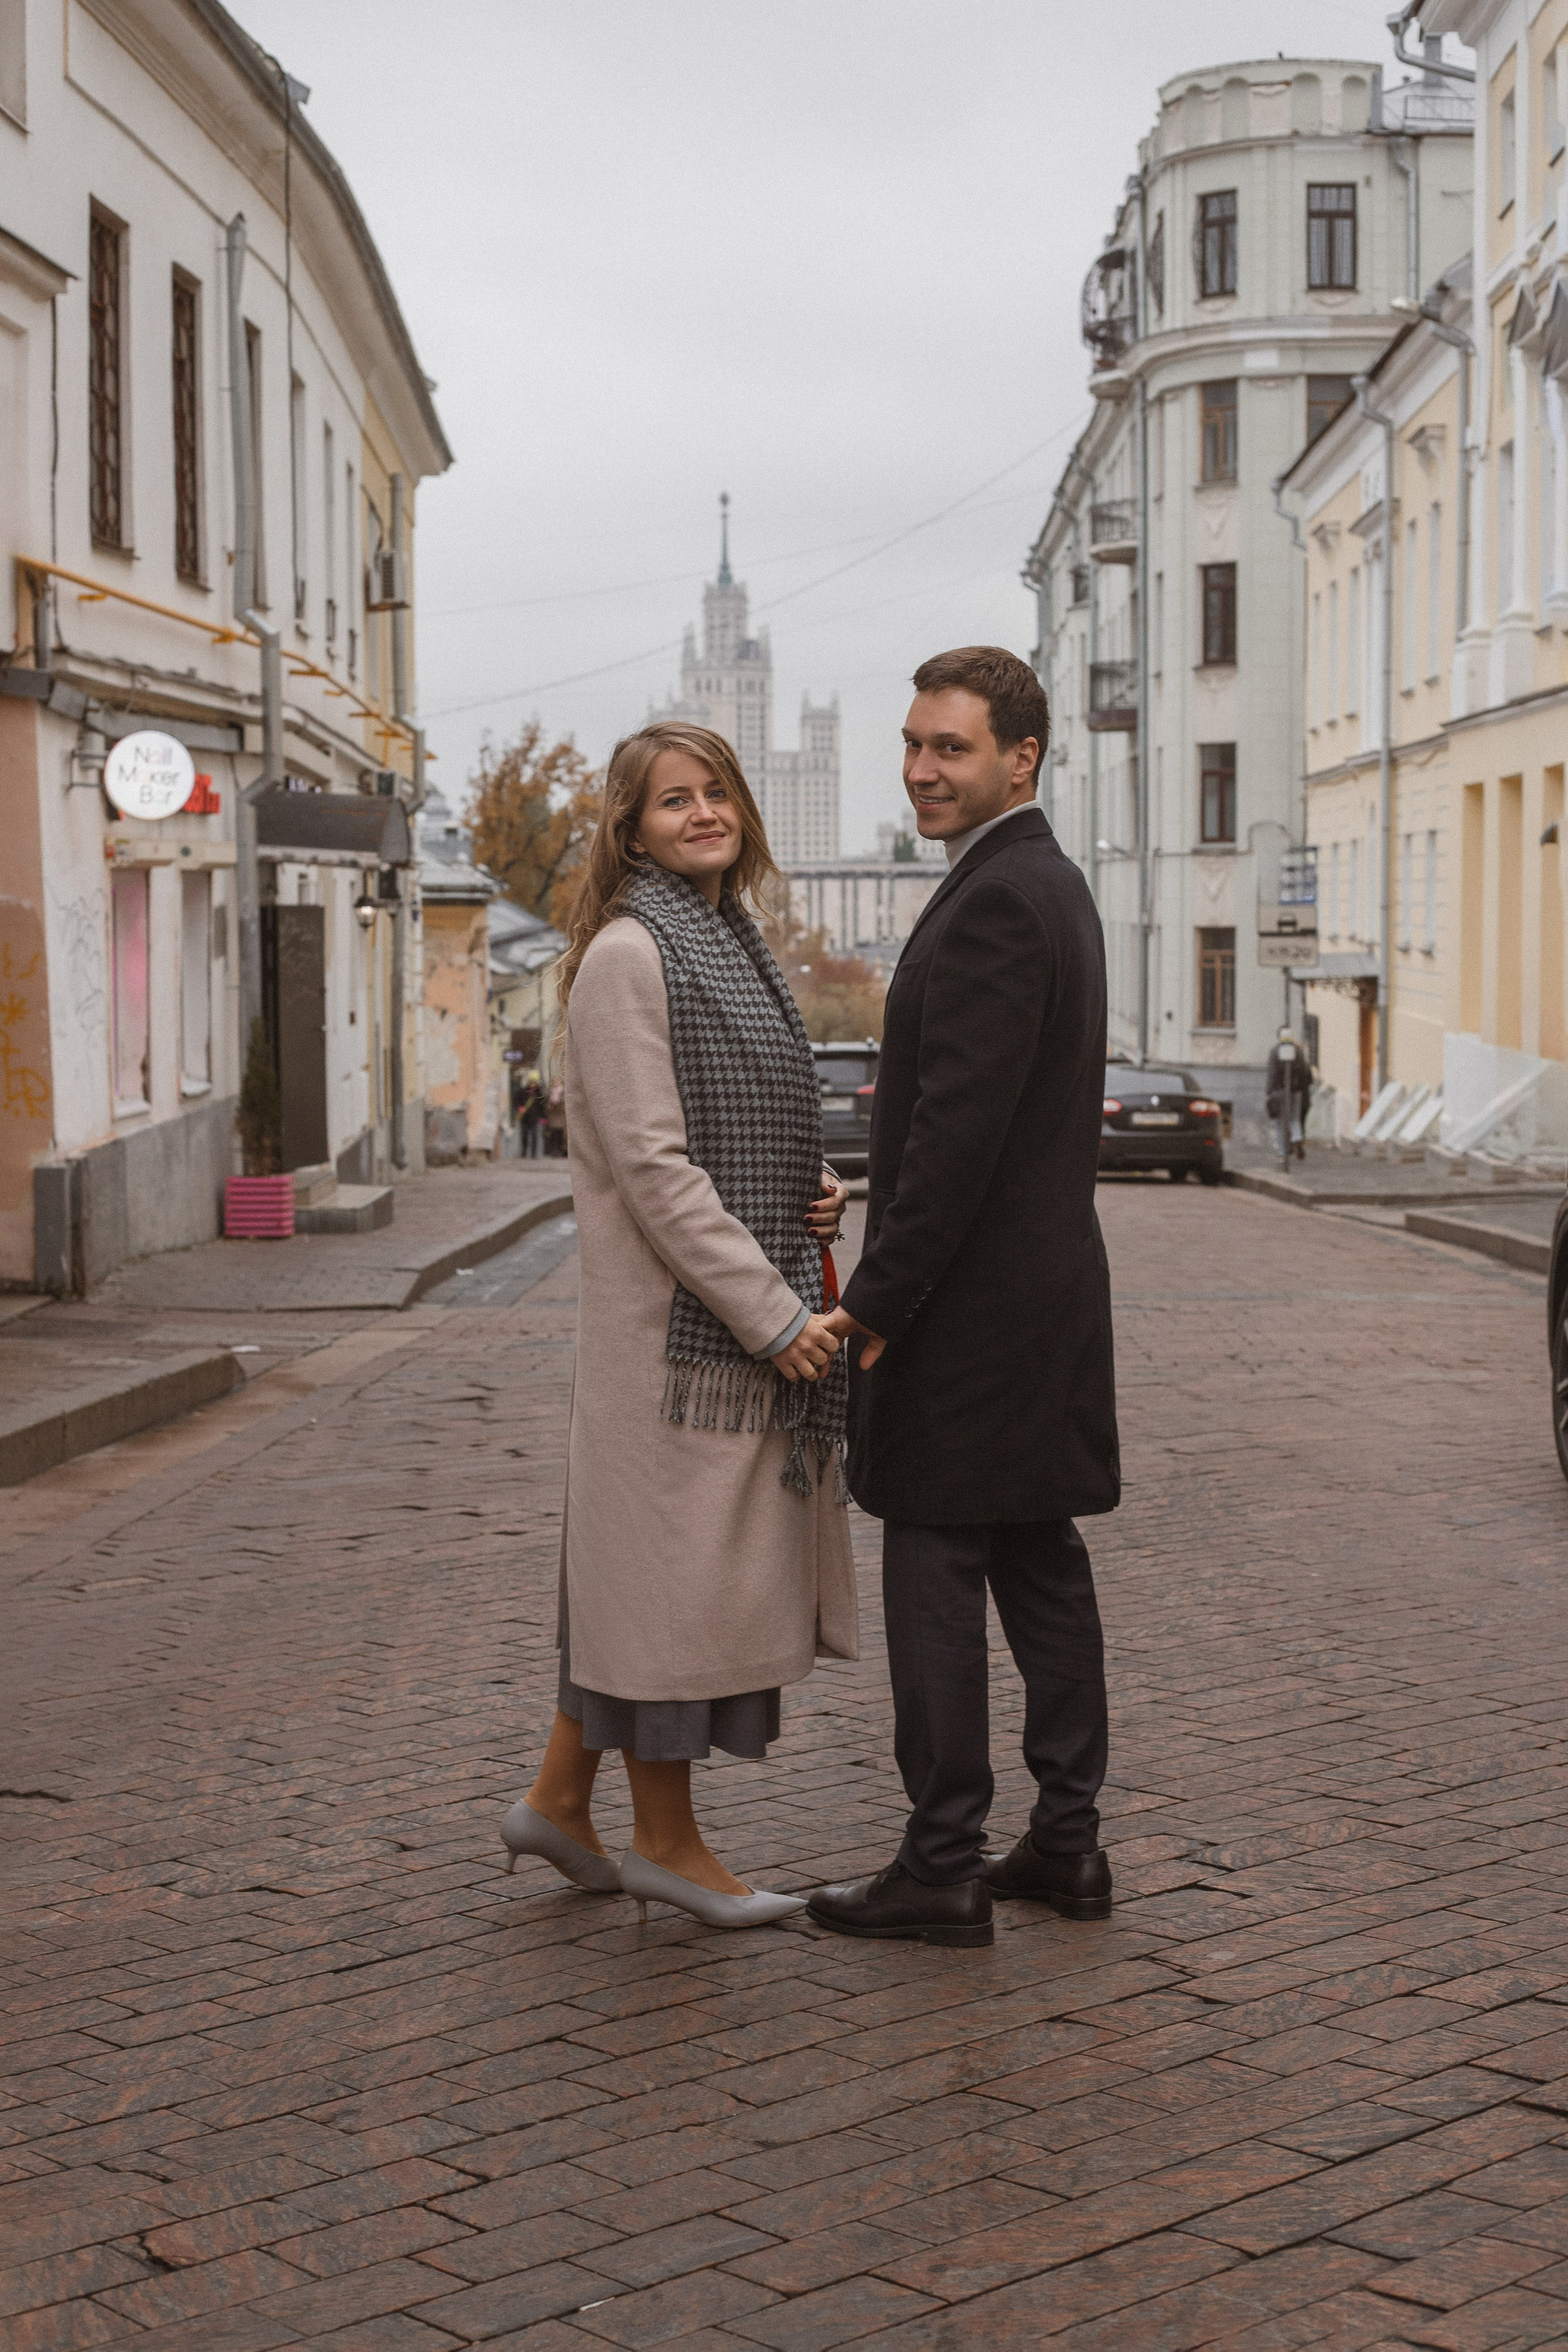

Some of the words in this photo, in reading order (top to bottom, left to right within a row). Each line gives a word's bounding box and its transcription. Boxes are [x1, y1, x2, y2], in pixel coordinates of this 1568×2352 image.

[134, 745, 173, 765] Nail
[118, 764, 180, 785] Maker
[139, 784, 172, 805] Bar
